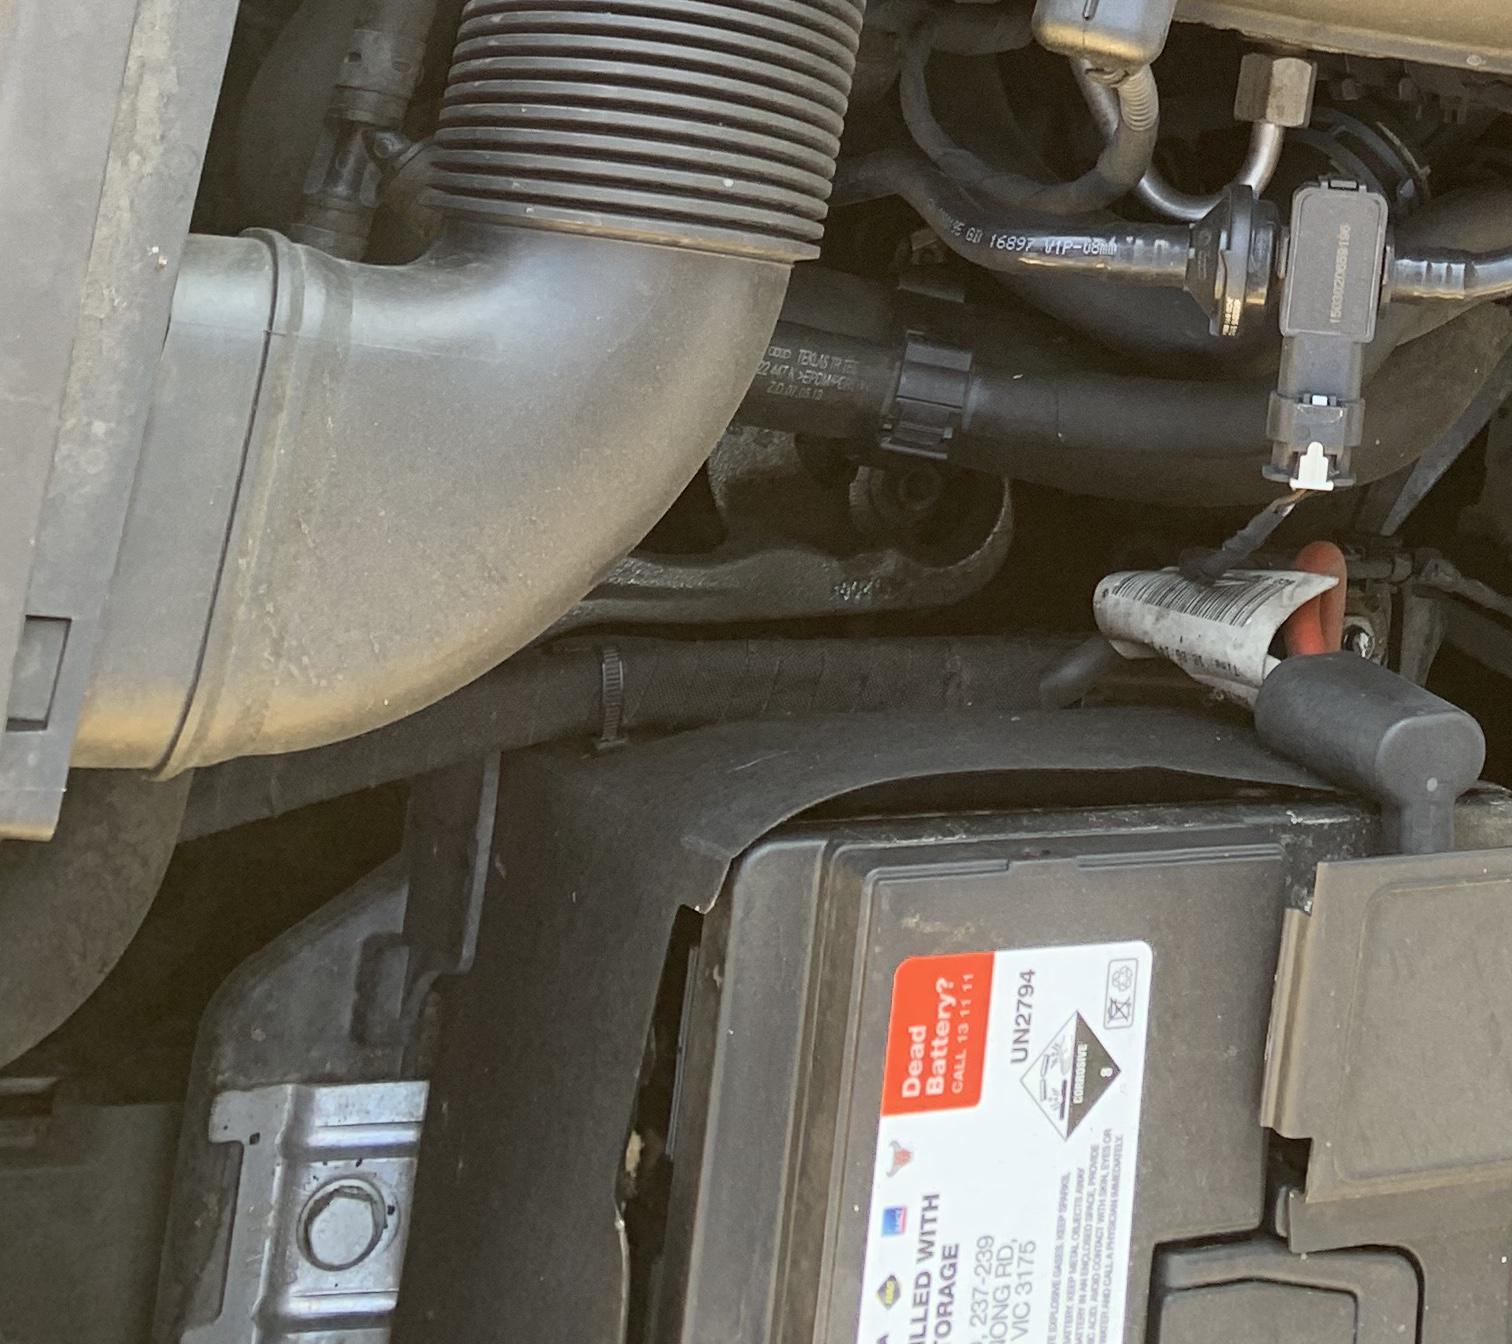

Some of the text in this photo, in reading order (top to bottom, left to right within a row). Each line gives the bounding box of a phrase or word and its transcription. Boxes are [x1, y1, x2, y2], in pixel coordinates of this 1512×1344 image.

[989, 233, 1034, 251] 16897
[924, 976, 958, 1097] Battery?
[951, 972, 973, 1094] CALL 13 11 11
[1010, 967, 1036, 1064] UN2794
[900, 1023, 927, 1099] Dead
[1073, 1043, 1087, 1104] CORROSIVE
[1099, 1144, 1111, 1170] EYES
[1102, 1127, 1112, 1144] OR
[915, 1191, 939, 1265] WITH
[1055, 1214, 1066, 1240] KEEP
[1070, 1195, 1083, 1241] OBJECTS
[1079, 1223, 1093, 1277] ENCLOSED
[1087, 1143, 1099, 1186] PROVIDE
[1095, 1198, 1106, 1224] WITH
[1105, 1197, 1118, 1251] PHYSICIAN
[995, 1235, 1018, 1278] RD,
[1068, 1242, 1079, 1274] METAL
[1092, 1225, 1104, 1270] CONTACT
[933, 1241, 959, 1344] ORAGE
[968, 1233, 995, 1328] 237-239
[1010, 1238, 1037, 1341] VIC 3175
[1065, 1275, 1076, 1301] KEEP
[1089, 1271, 1100, 1302] AVOID
[1102, 1260, 1113, 1287] CALL
